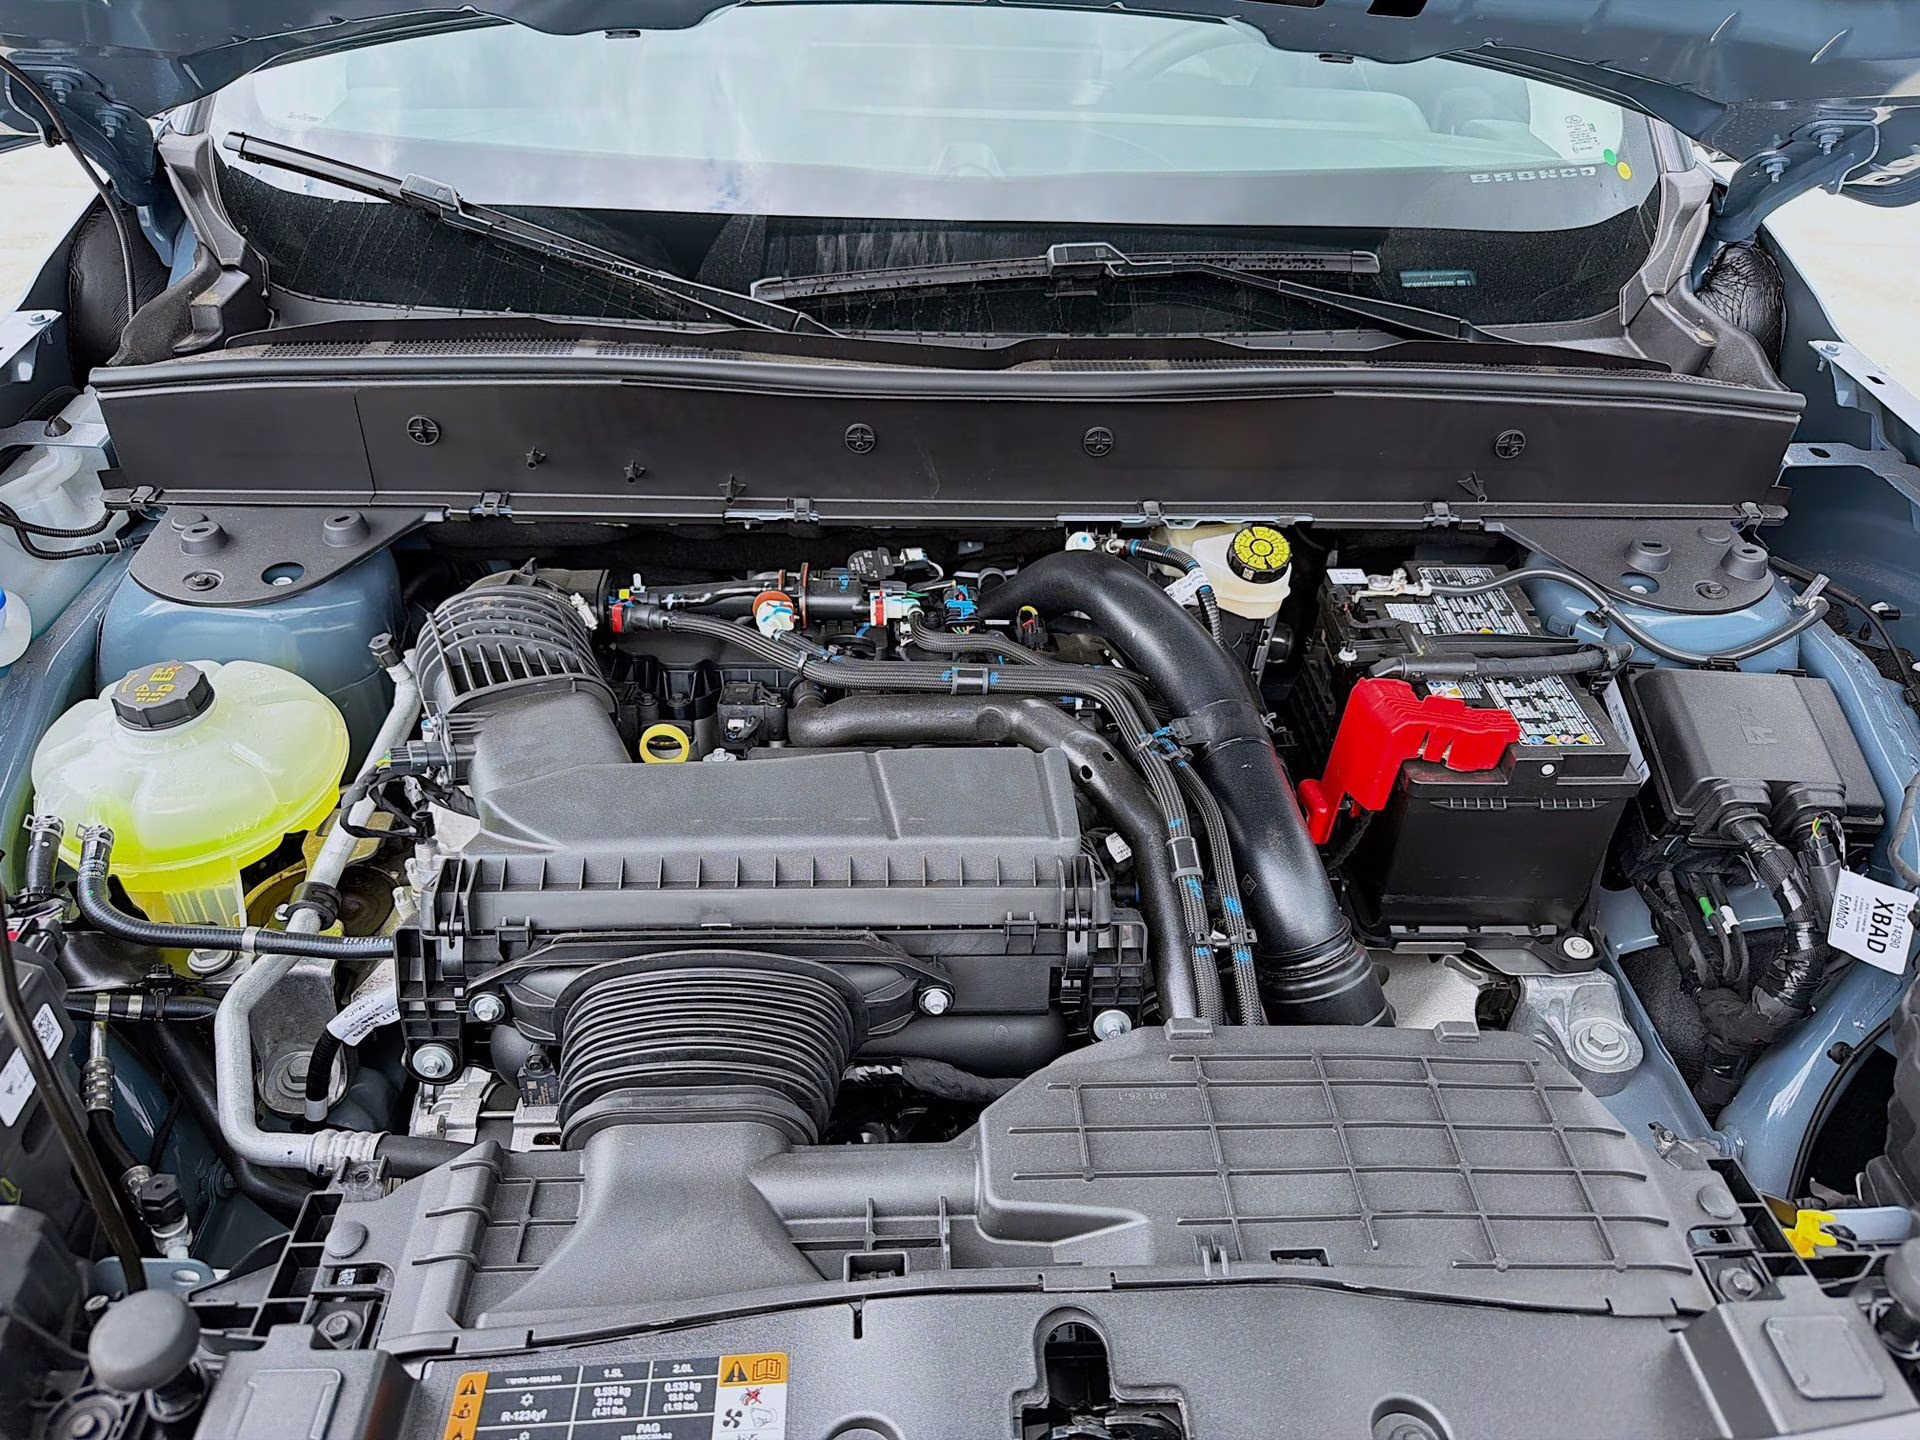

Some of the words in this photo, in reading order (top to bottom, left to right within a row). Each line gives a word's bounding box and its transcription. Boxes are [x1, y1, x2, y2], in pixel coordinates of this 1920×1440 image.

[1470, 167, 1596, 184] BRONCO
[1835, 893, 1852, 929] FoMoCo
[1897, 902, 1908, 923] TZ1T
[1867, 897, 1895, 954] XBAD
[1889, 925, 1904, 949] 14290
[602, 1368, 624, 1378] 1.5L
[672, 1363, 694, 1374] 2.0L
[619, 1385, 632, 1397] kg
[689, 1381, 702, 1393] kg
[500, 1408, 548, 1422] R-1234yf
[636, 1423, 661, 1433] PAG
